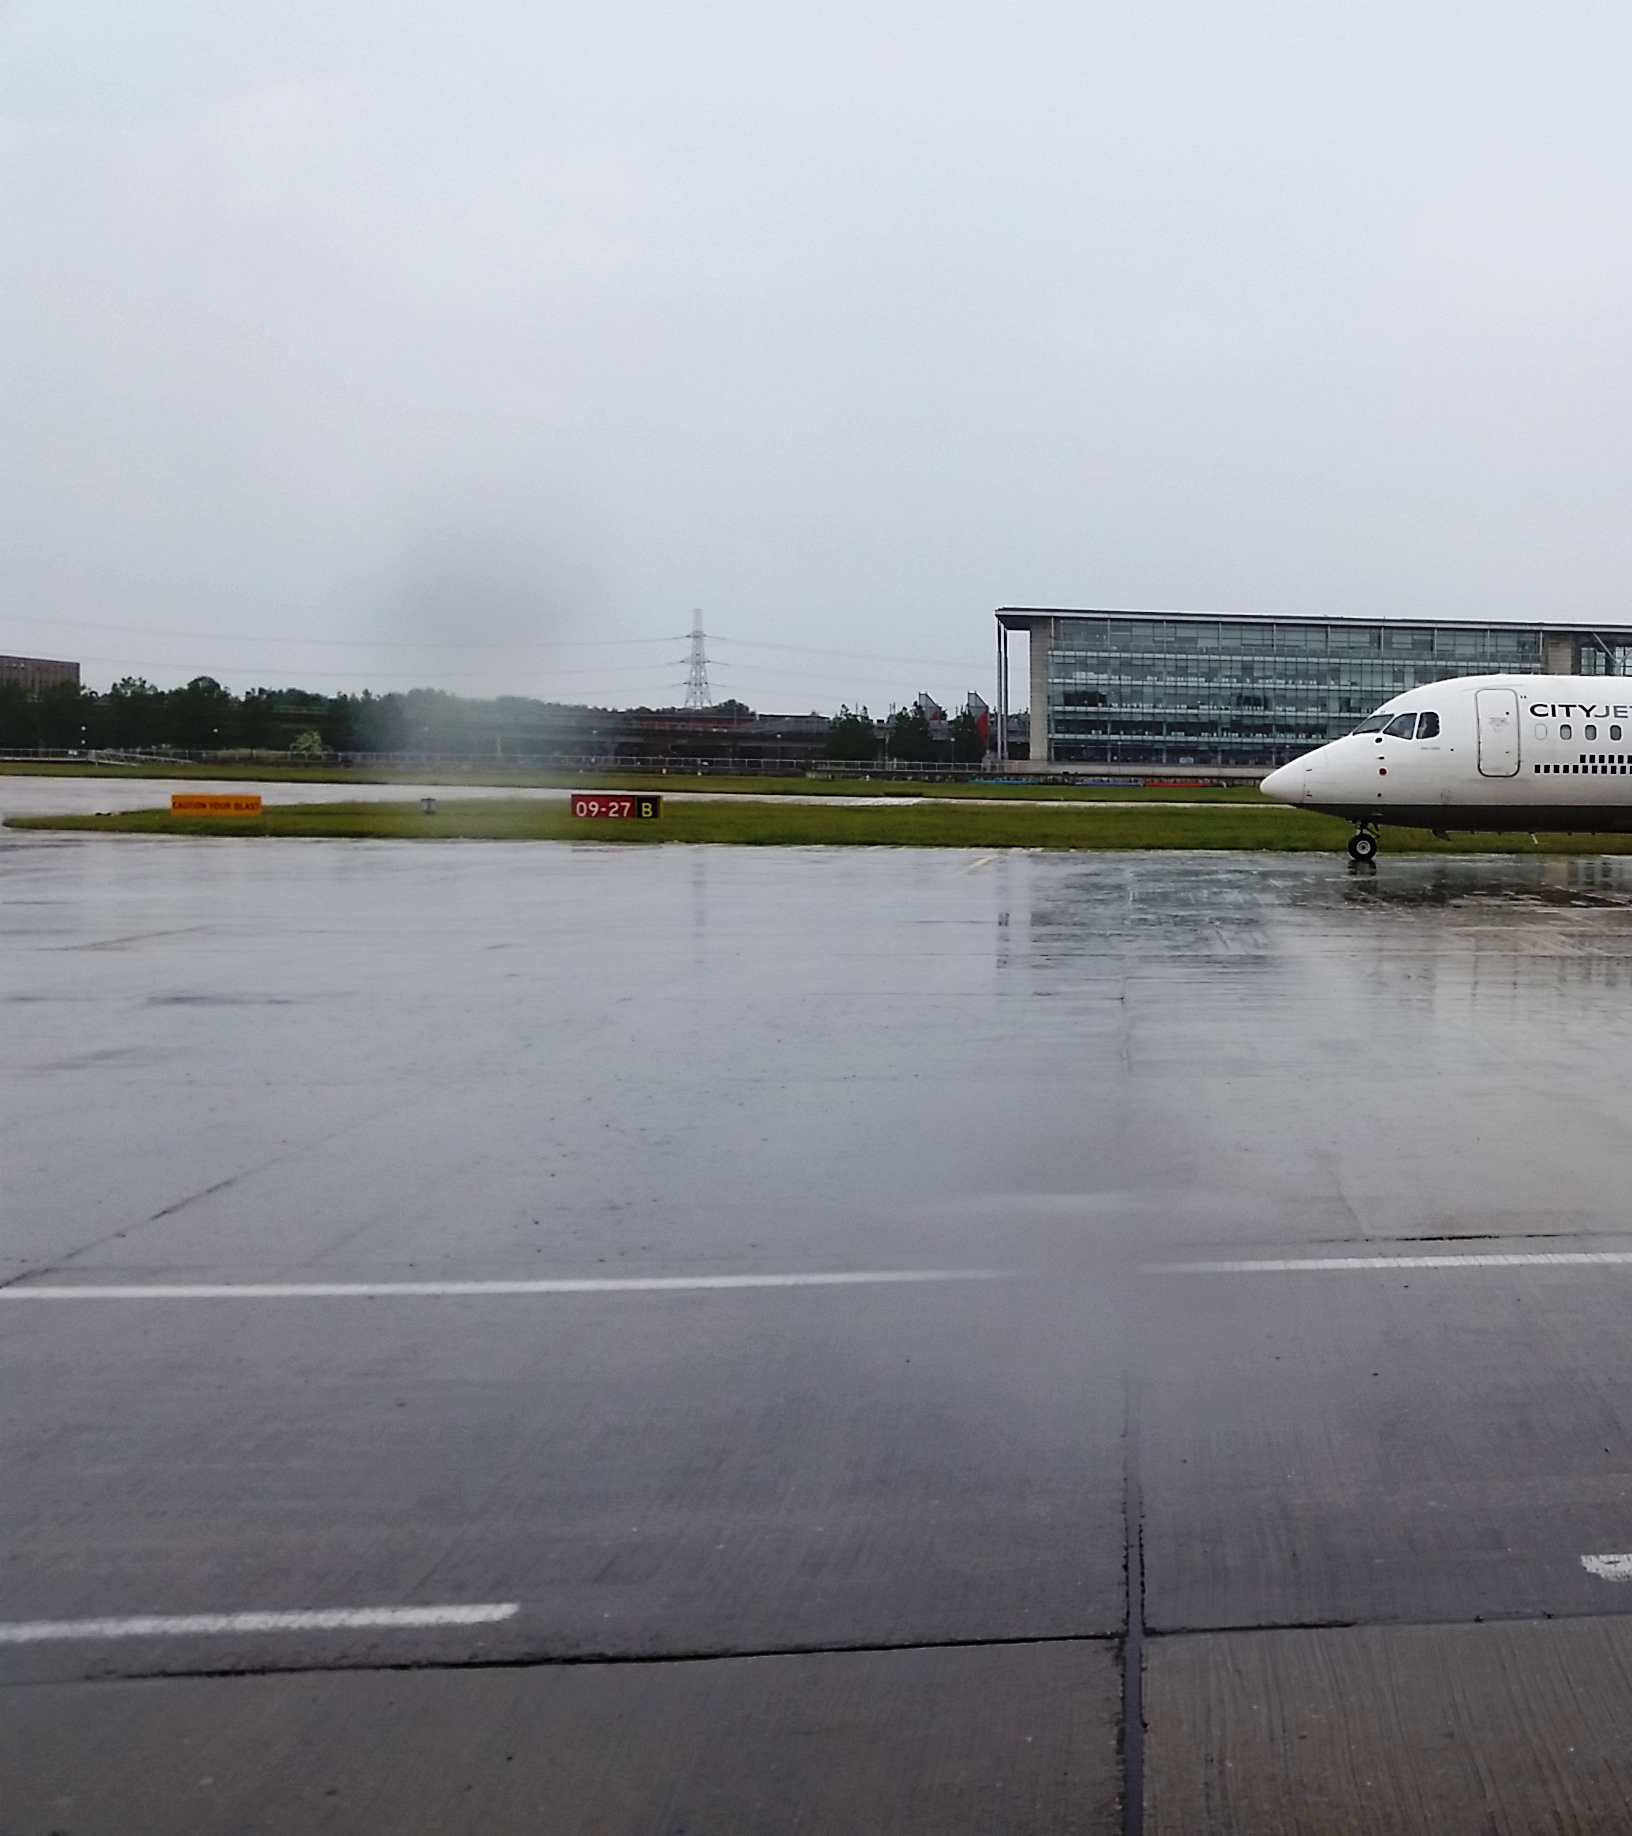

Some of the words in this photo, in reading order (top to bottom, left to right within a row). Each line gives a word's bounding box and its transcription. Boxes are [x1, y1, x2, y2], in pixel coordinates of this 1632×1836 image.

[172, 801, 206, 810] CAUTION
[209, 802, 231, 810] YOUR
[234, 802, 260, 811] BLAST
[576, 801, 631, 817] 09-27
[641, 802, 653, 817] B
